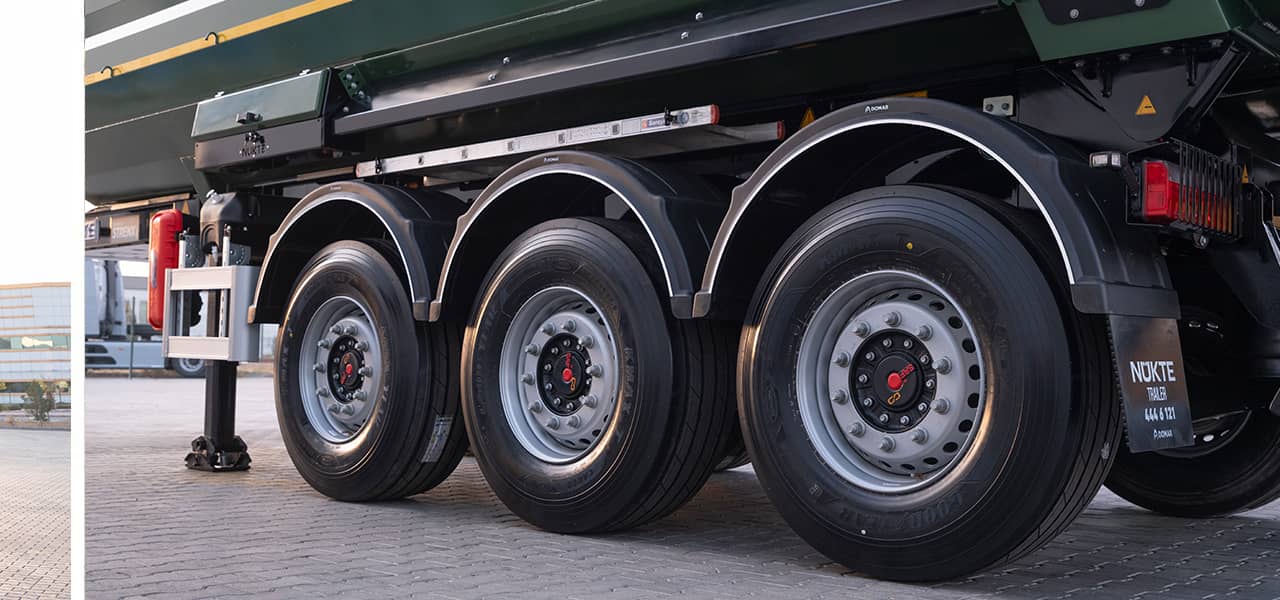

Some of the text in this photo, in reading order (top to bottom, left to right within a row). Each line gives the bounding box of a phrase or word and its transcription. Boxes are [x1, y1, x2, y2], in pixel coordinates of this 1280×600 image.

[1144, 406, 1176, 421] 444 6 121
